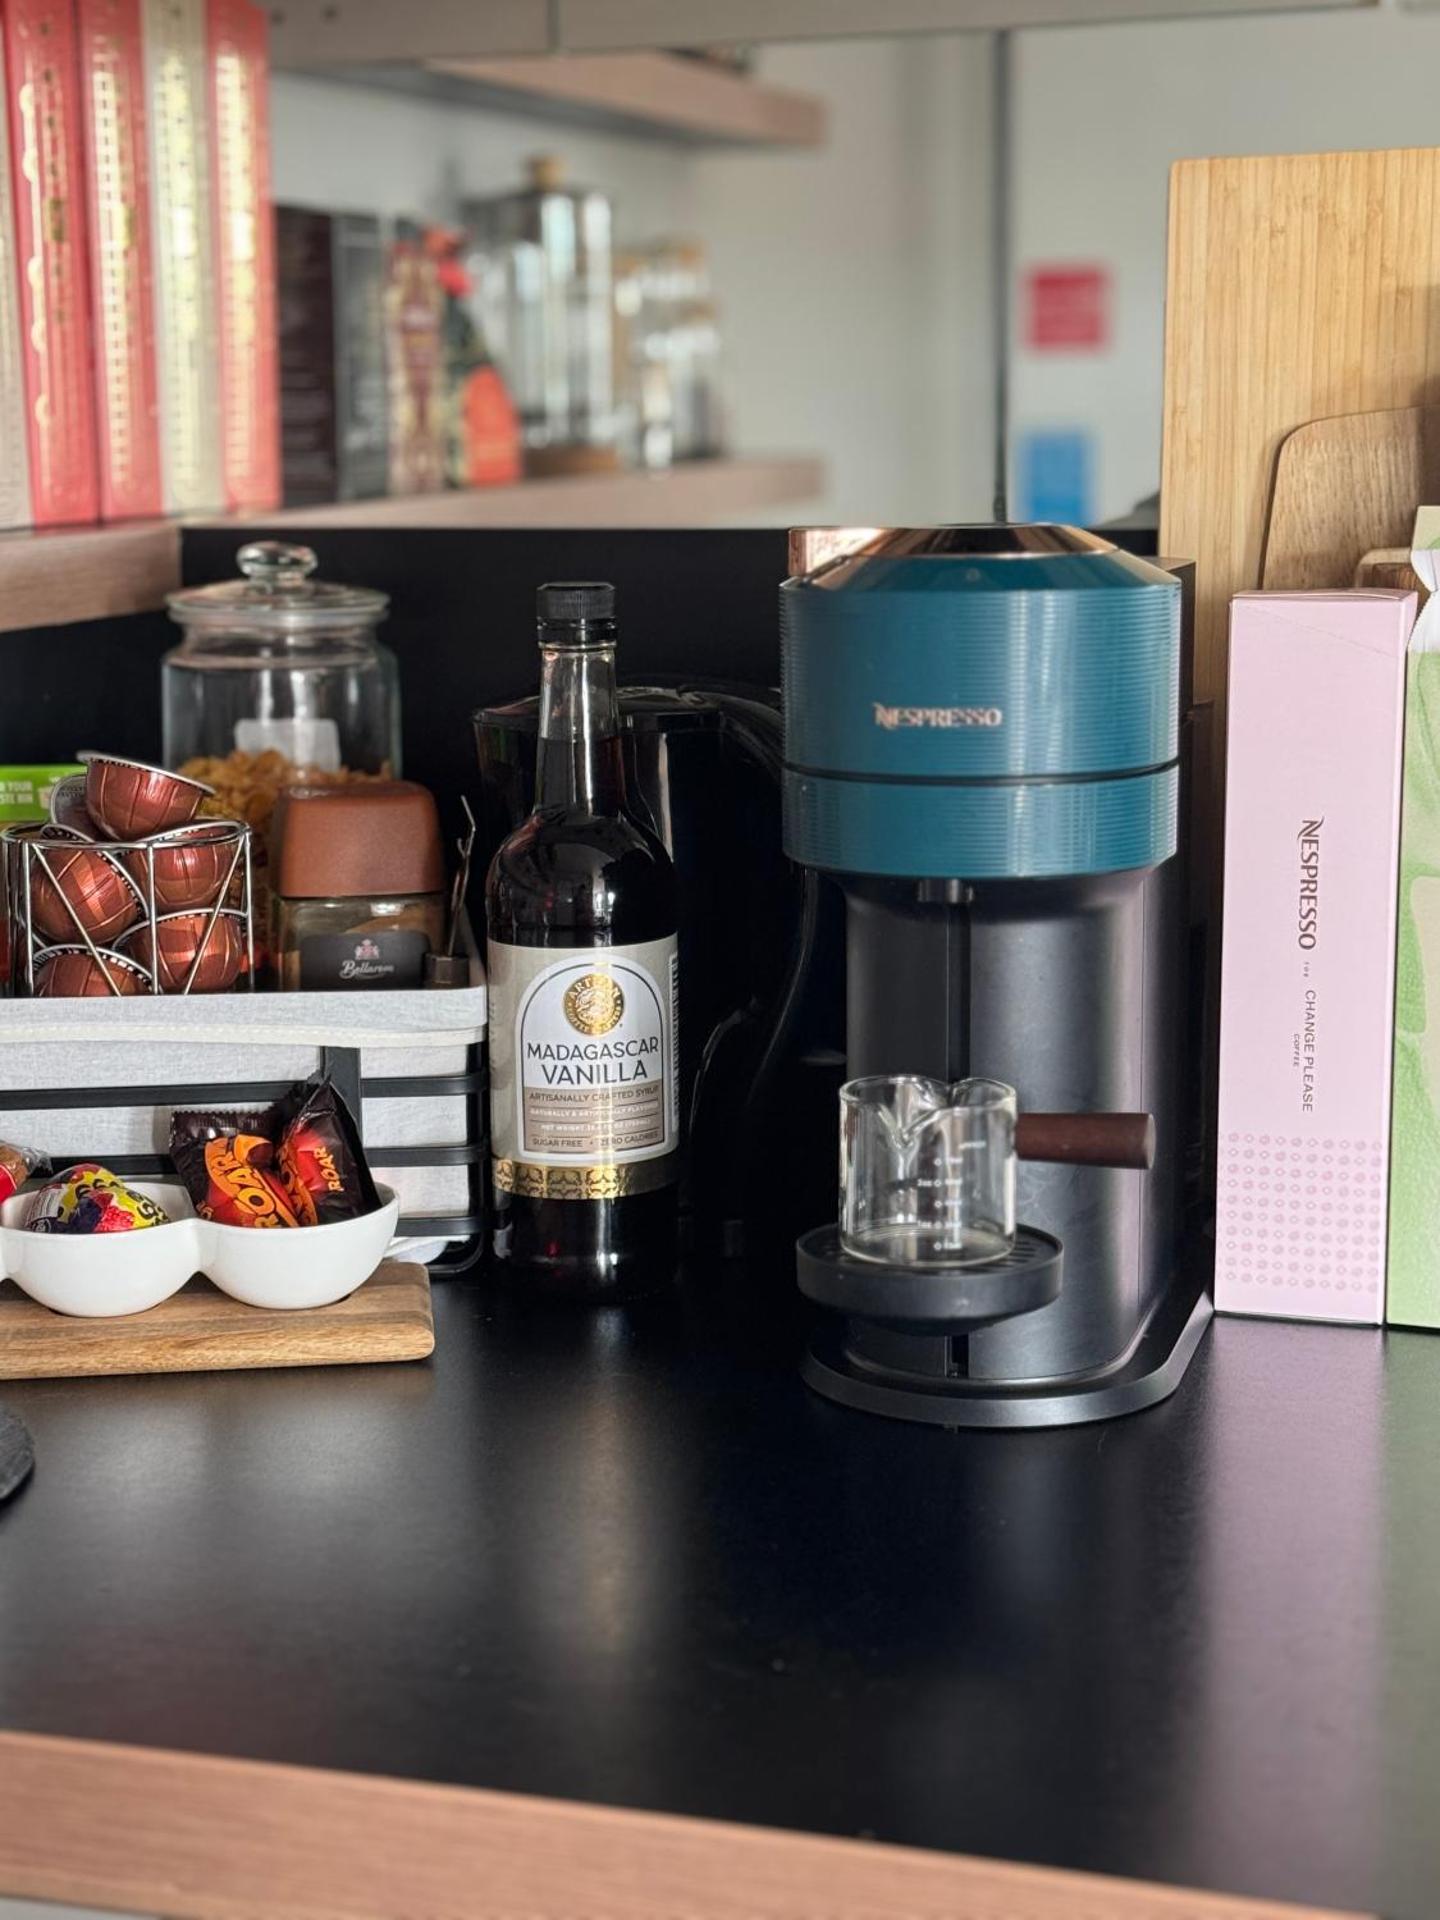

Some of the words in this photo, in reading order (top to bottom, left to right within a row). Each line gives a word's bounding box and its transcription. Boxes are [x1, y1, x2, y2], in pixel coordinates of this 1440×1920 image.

[873, 702, 1002, 729] NESPRESSO
[1297, 816, 1324, 950] NESPRESSO
[1304, 990, 1317, 1053] CHANGE
[527, 1036, 659, 1061] MADAGASCAR
[541, 1059, 648, 1086] VANILLA
[1302, 1056, 1315, 1113] PLEASE
[529, 1091, 590, 1102] ARTISANALLY
[591, 1090, 634, 1102] CRAFTED
[635, 1084, 659, 1098] SYRUP
[532, 1138, 560, 1147] SUGAR
[561, 1139, 583, 1148] FREE
[600, 1137, 624, 1147] ZERO
[314, 1146, 345, 1192] ROAR
